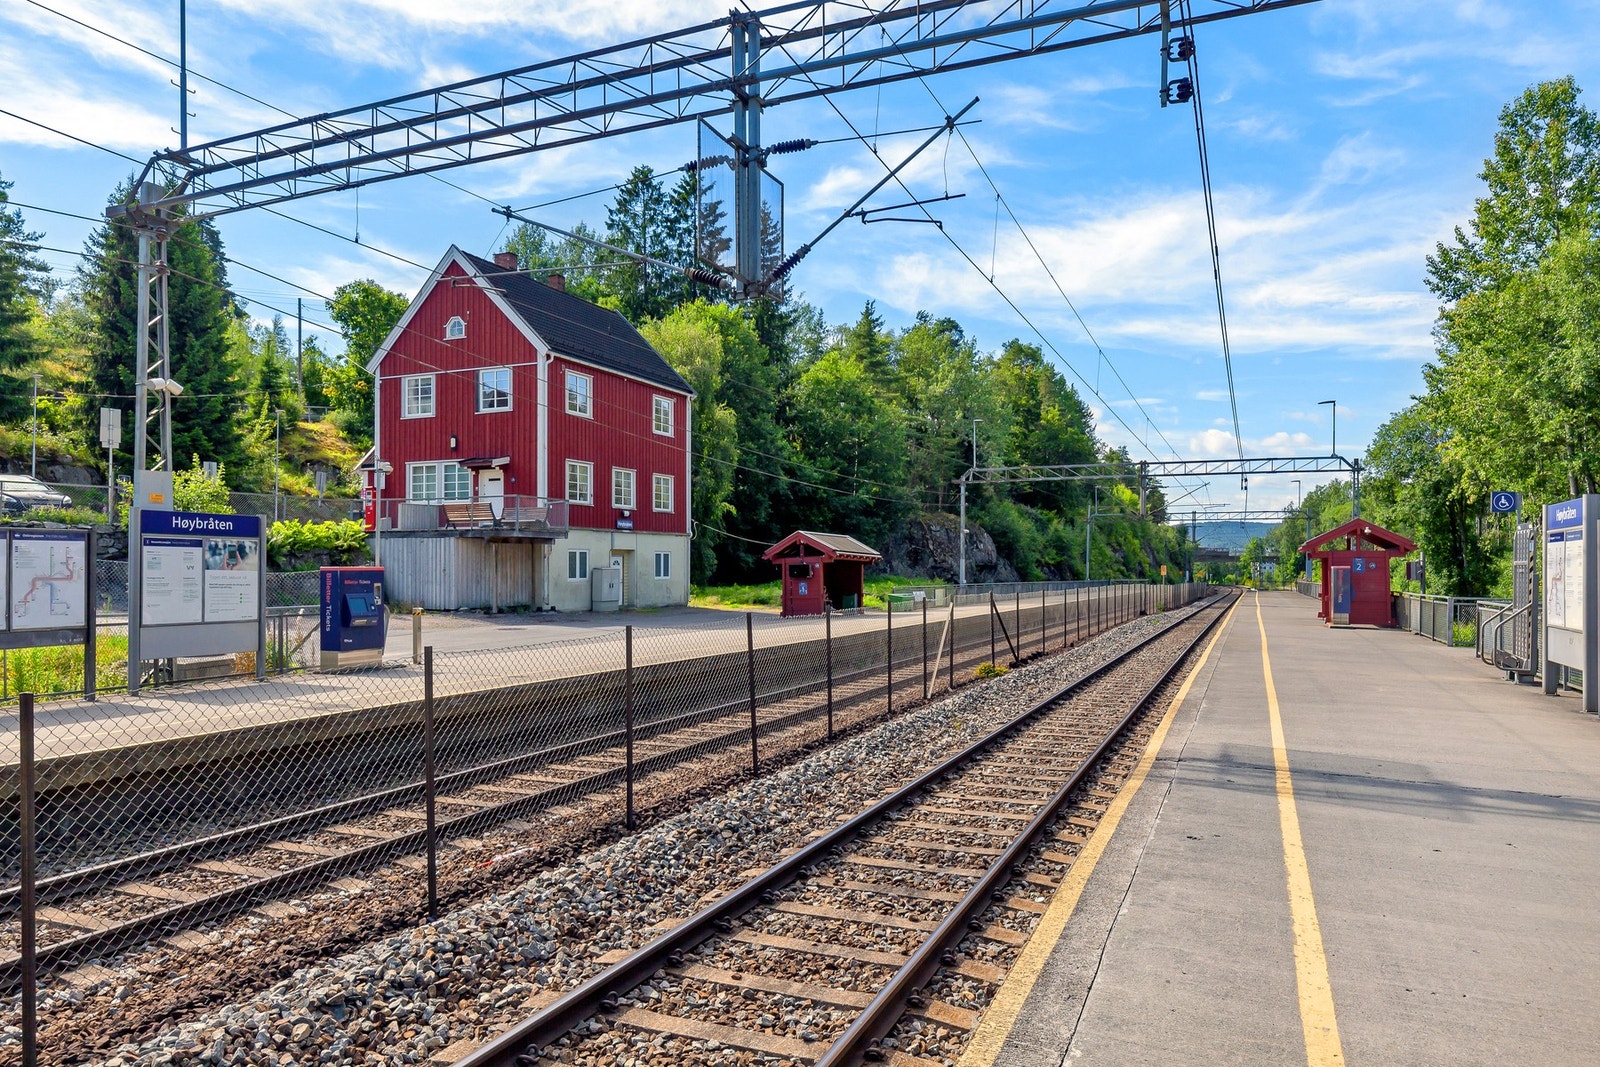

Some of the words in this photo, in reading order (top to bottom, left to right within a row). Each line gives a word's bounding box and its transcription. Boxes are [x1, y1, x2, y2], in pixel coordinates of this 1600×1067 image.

[1555, 505, 1577, 524] Høybråten
[172, 516, 233, 531] Høybråten
[1356, 563, 1362, 571] 2
